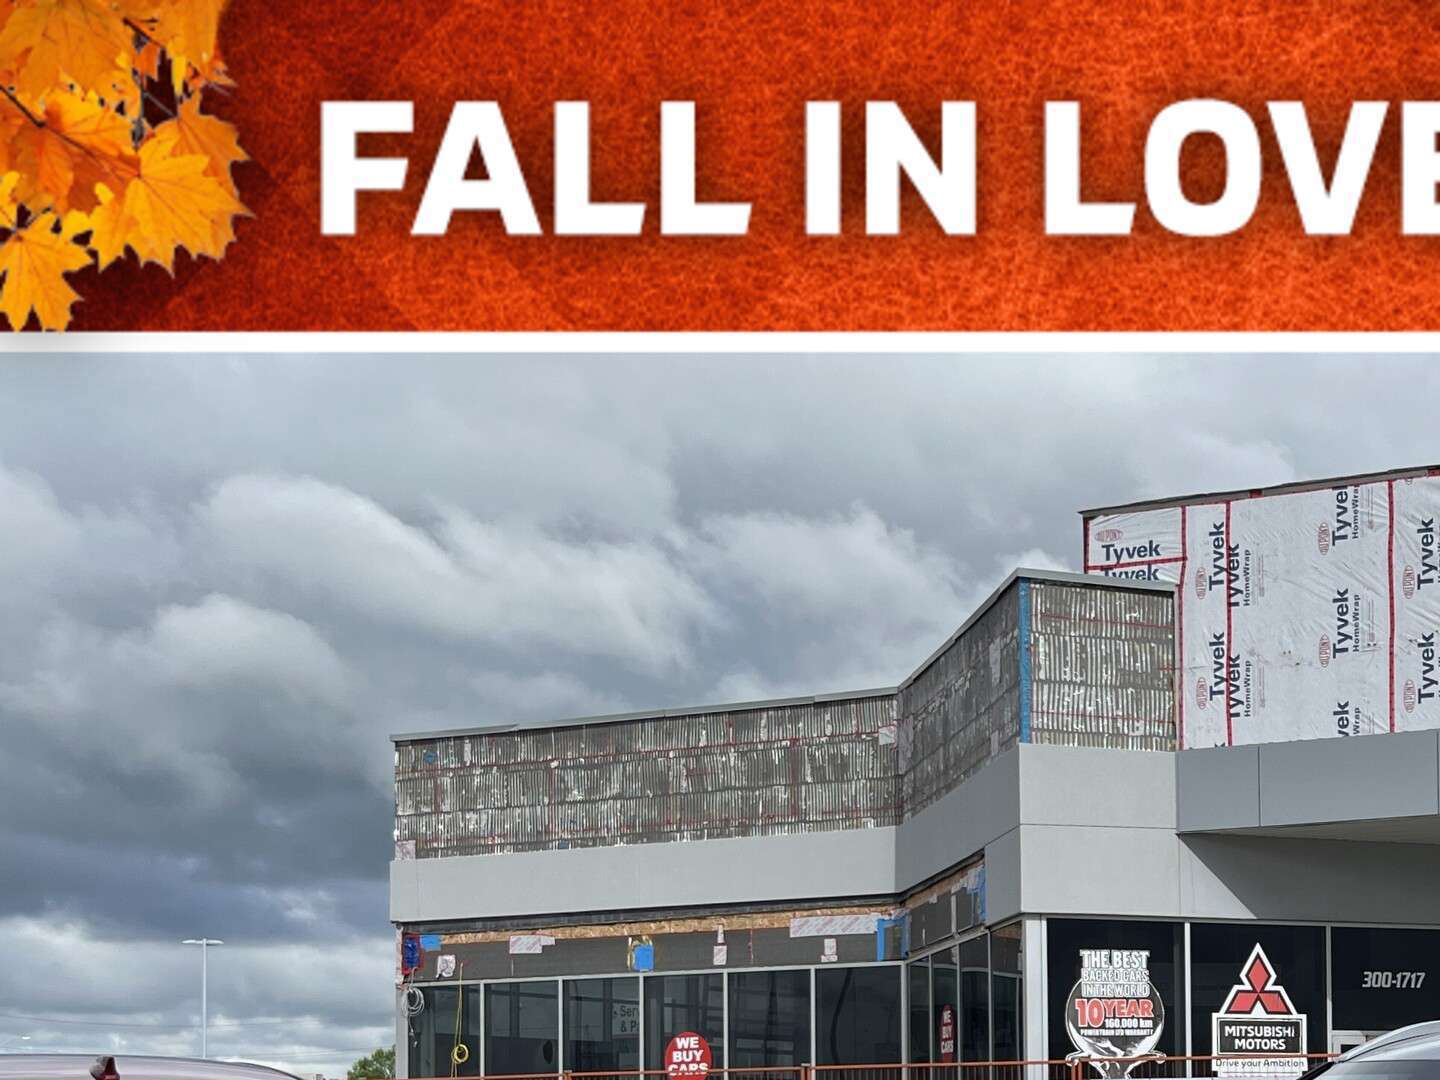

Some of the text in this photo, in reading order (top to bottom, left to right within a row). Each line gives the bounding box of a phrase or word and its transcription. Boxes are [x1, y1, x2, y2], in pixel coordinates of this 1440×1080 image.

[1352, 486, 1360, 539] HomeWra
[1101, 540, 1162, 564] Tyvek
[1208, 521, 1229, 591] Tyvek
[1417, 517, 1438, 590] Tyvek
[1243, 550, 1251, 606] HomeWrap
[1332, 588, 1353, 659] Tyvek
[1352, 594, 1361, 652] HomeWrap
[1209, 632, 1228, 701] Tyvek
[1417, 632, 1438, 704] Tyvek
[1244, 660, 1252, 717] HomeWrap
[1333, 700, 1350, 737] vek
[1353, 707, 1361, 734] Wrap
[1081, 950, 1150, 968] THE BEST
[1082, 969, 1149, 982] BACKED CARS
[1362, 971, 1426, 989] 300-1717
[1082, 982, 1150, 997] IN THE WORLD
[1075, 998, 1105, 1028] 10
[1104, 999, 1154, 1018] YEAR
[1139, 1018, 1154, 1028] km
[1224, 1025, 1295, 1037] MITSUBISHI
[675, 1036, 700, 1050] WE
[1234, 1039, 1286, 1050] MOTORS
[672, 1050, 704, 1063] BUY
[1215, 1059, 1305, 1070] Drive your Ambition
[668, 1063, 709, 1076] CARS
